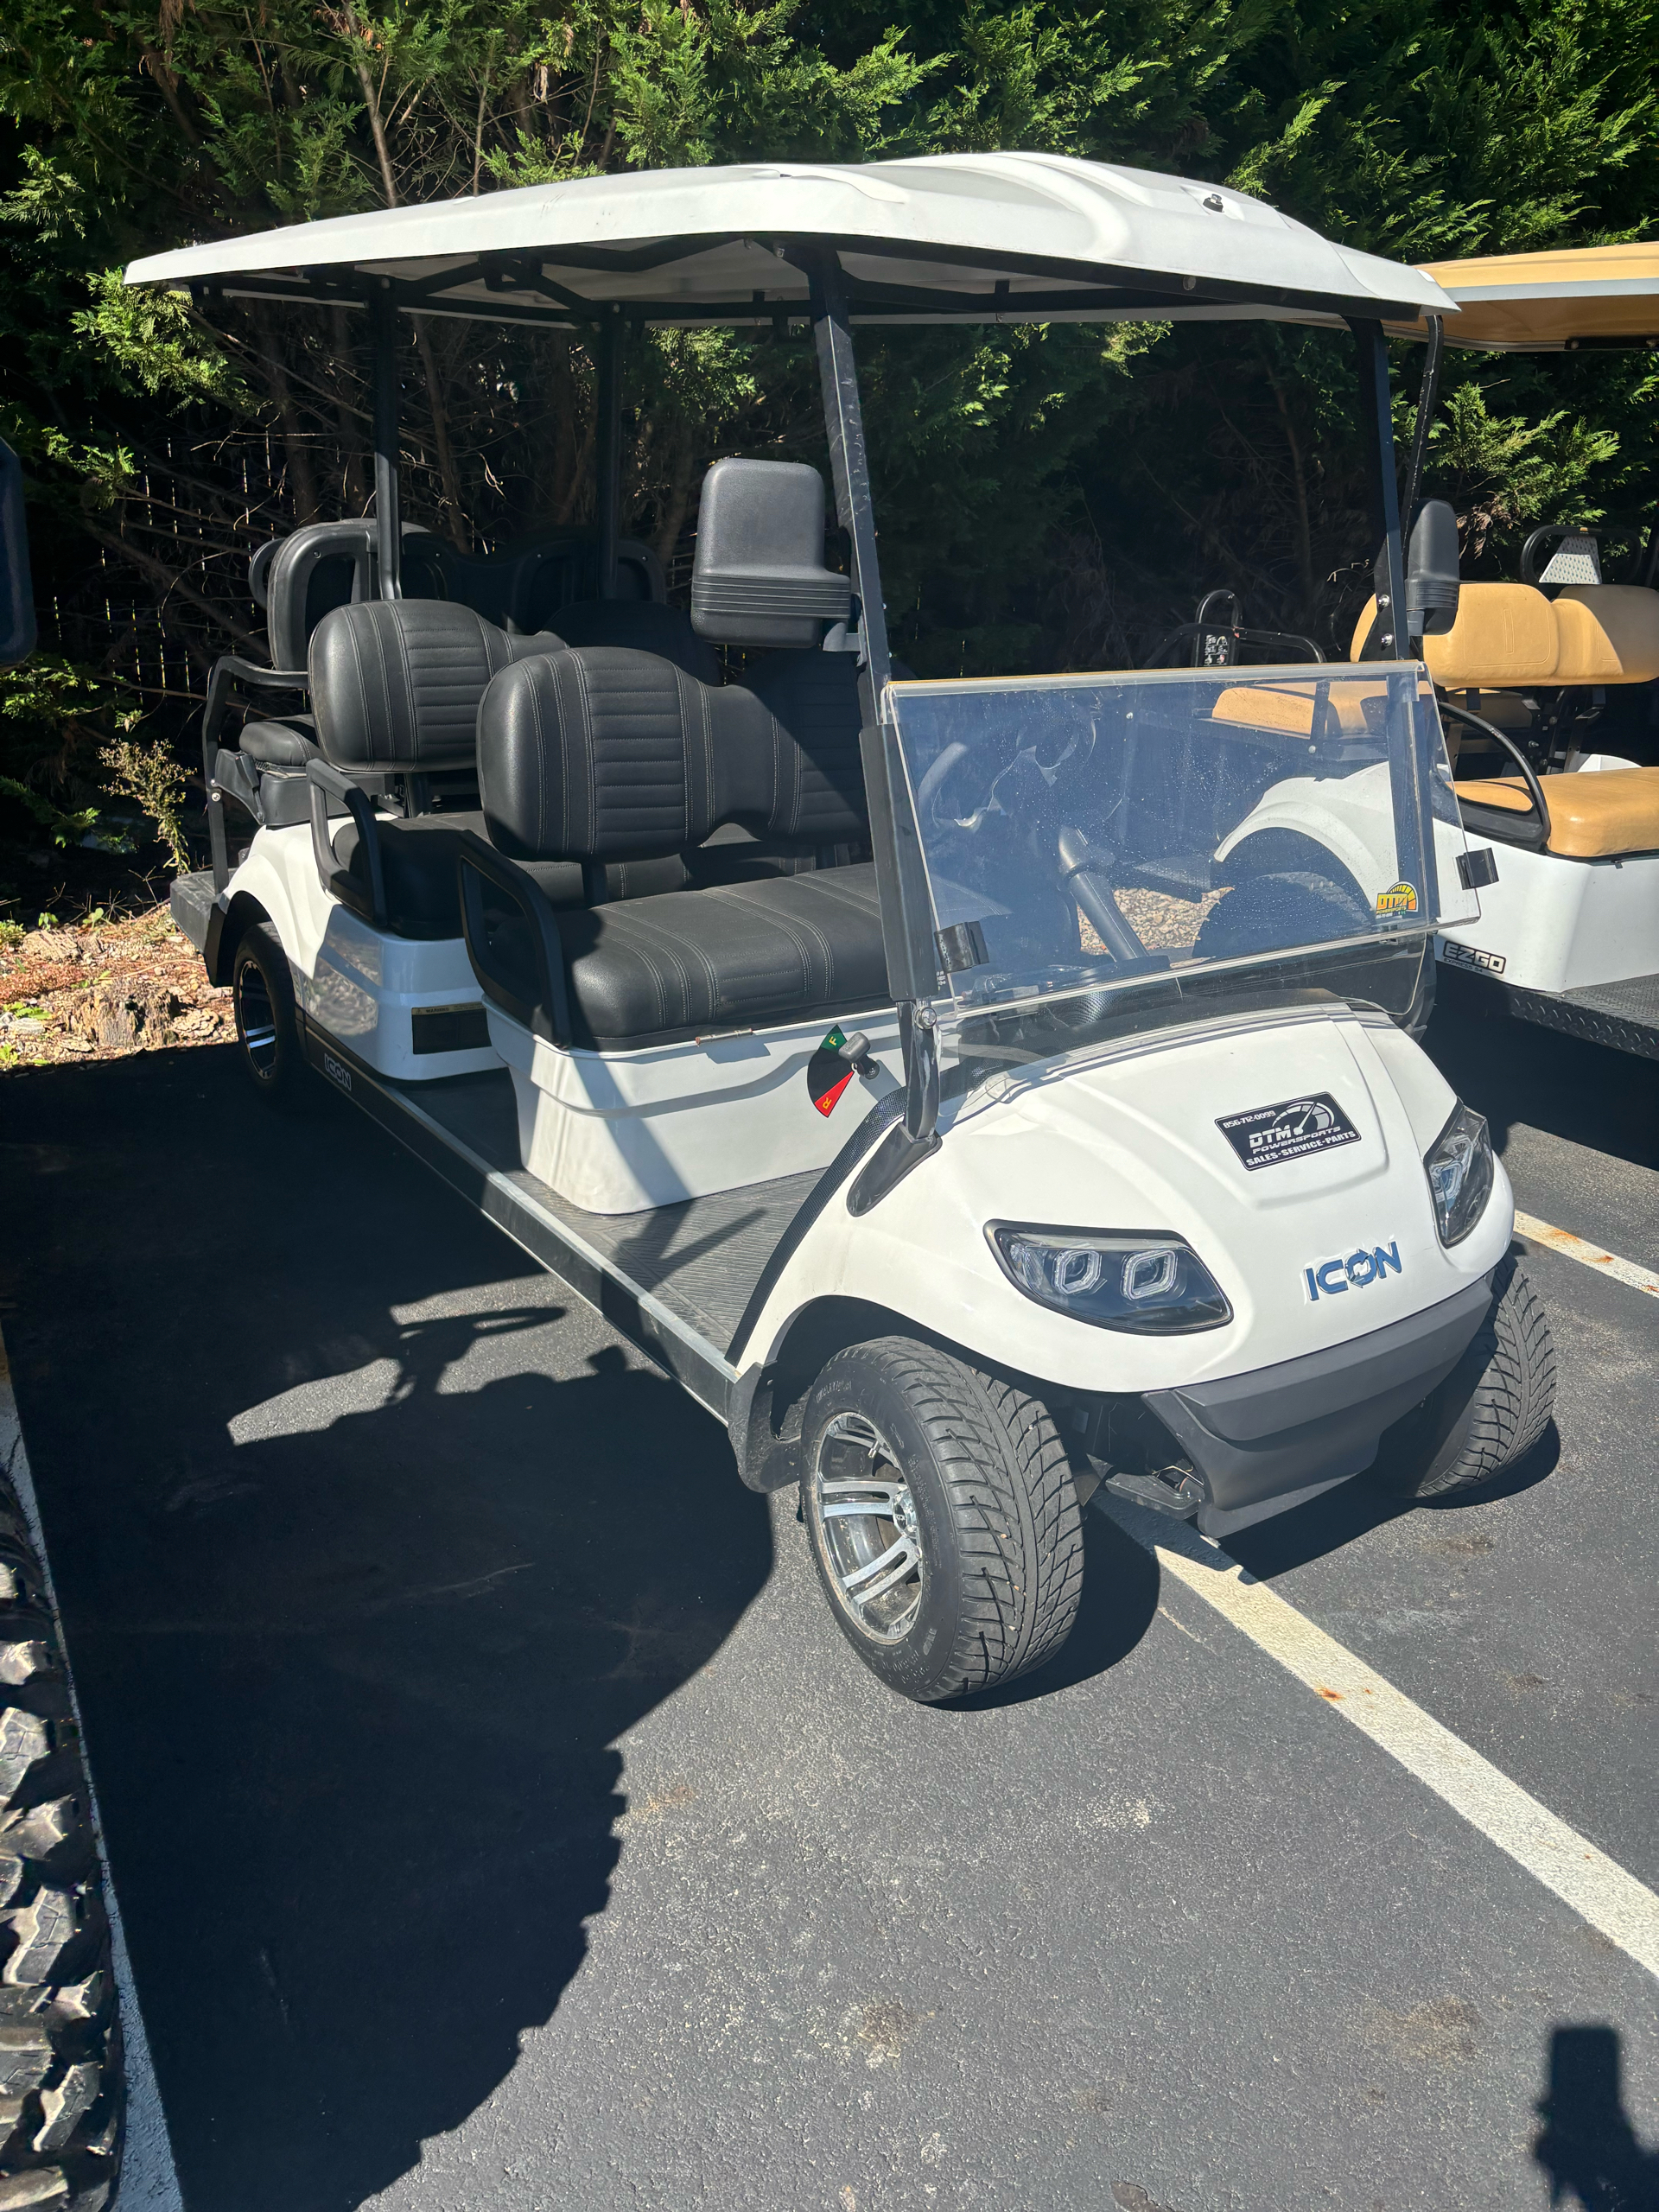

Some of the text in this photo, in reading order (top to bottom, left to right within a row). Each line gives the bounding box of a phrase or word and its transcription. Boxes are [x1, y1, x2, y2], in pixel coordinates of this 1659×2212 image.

[1444, 941, 1505, 973] EZGO
[1444, 957, 1473, 969] EXPRESS
[829, 1036, 837, 1046] F
[325, 1052, 352, 1091] ICON
[822, 1096, 832, 1109] R
[1249, 1124, 1292, 1148] DTM
[1252, 1125, 1341, 1154] POWERSPORTS
[1303, 1241, 1402, 1302] ICON
